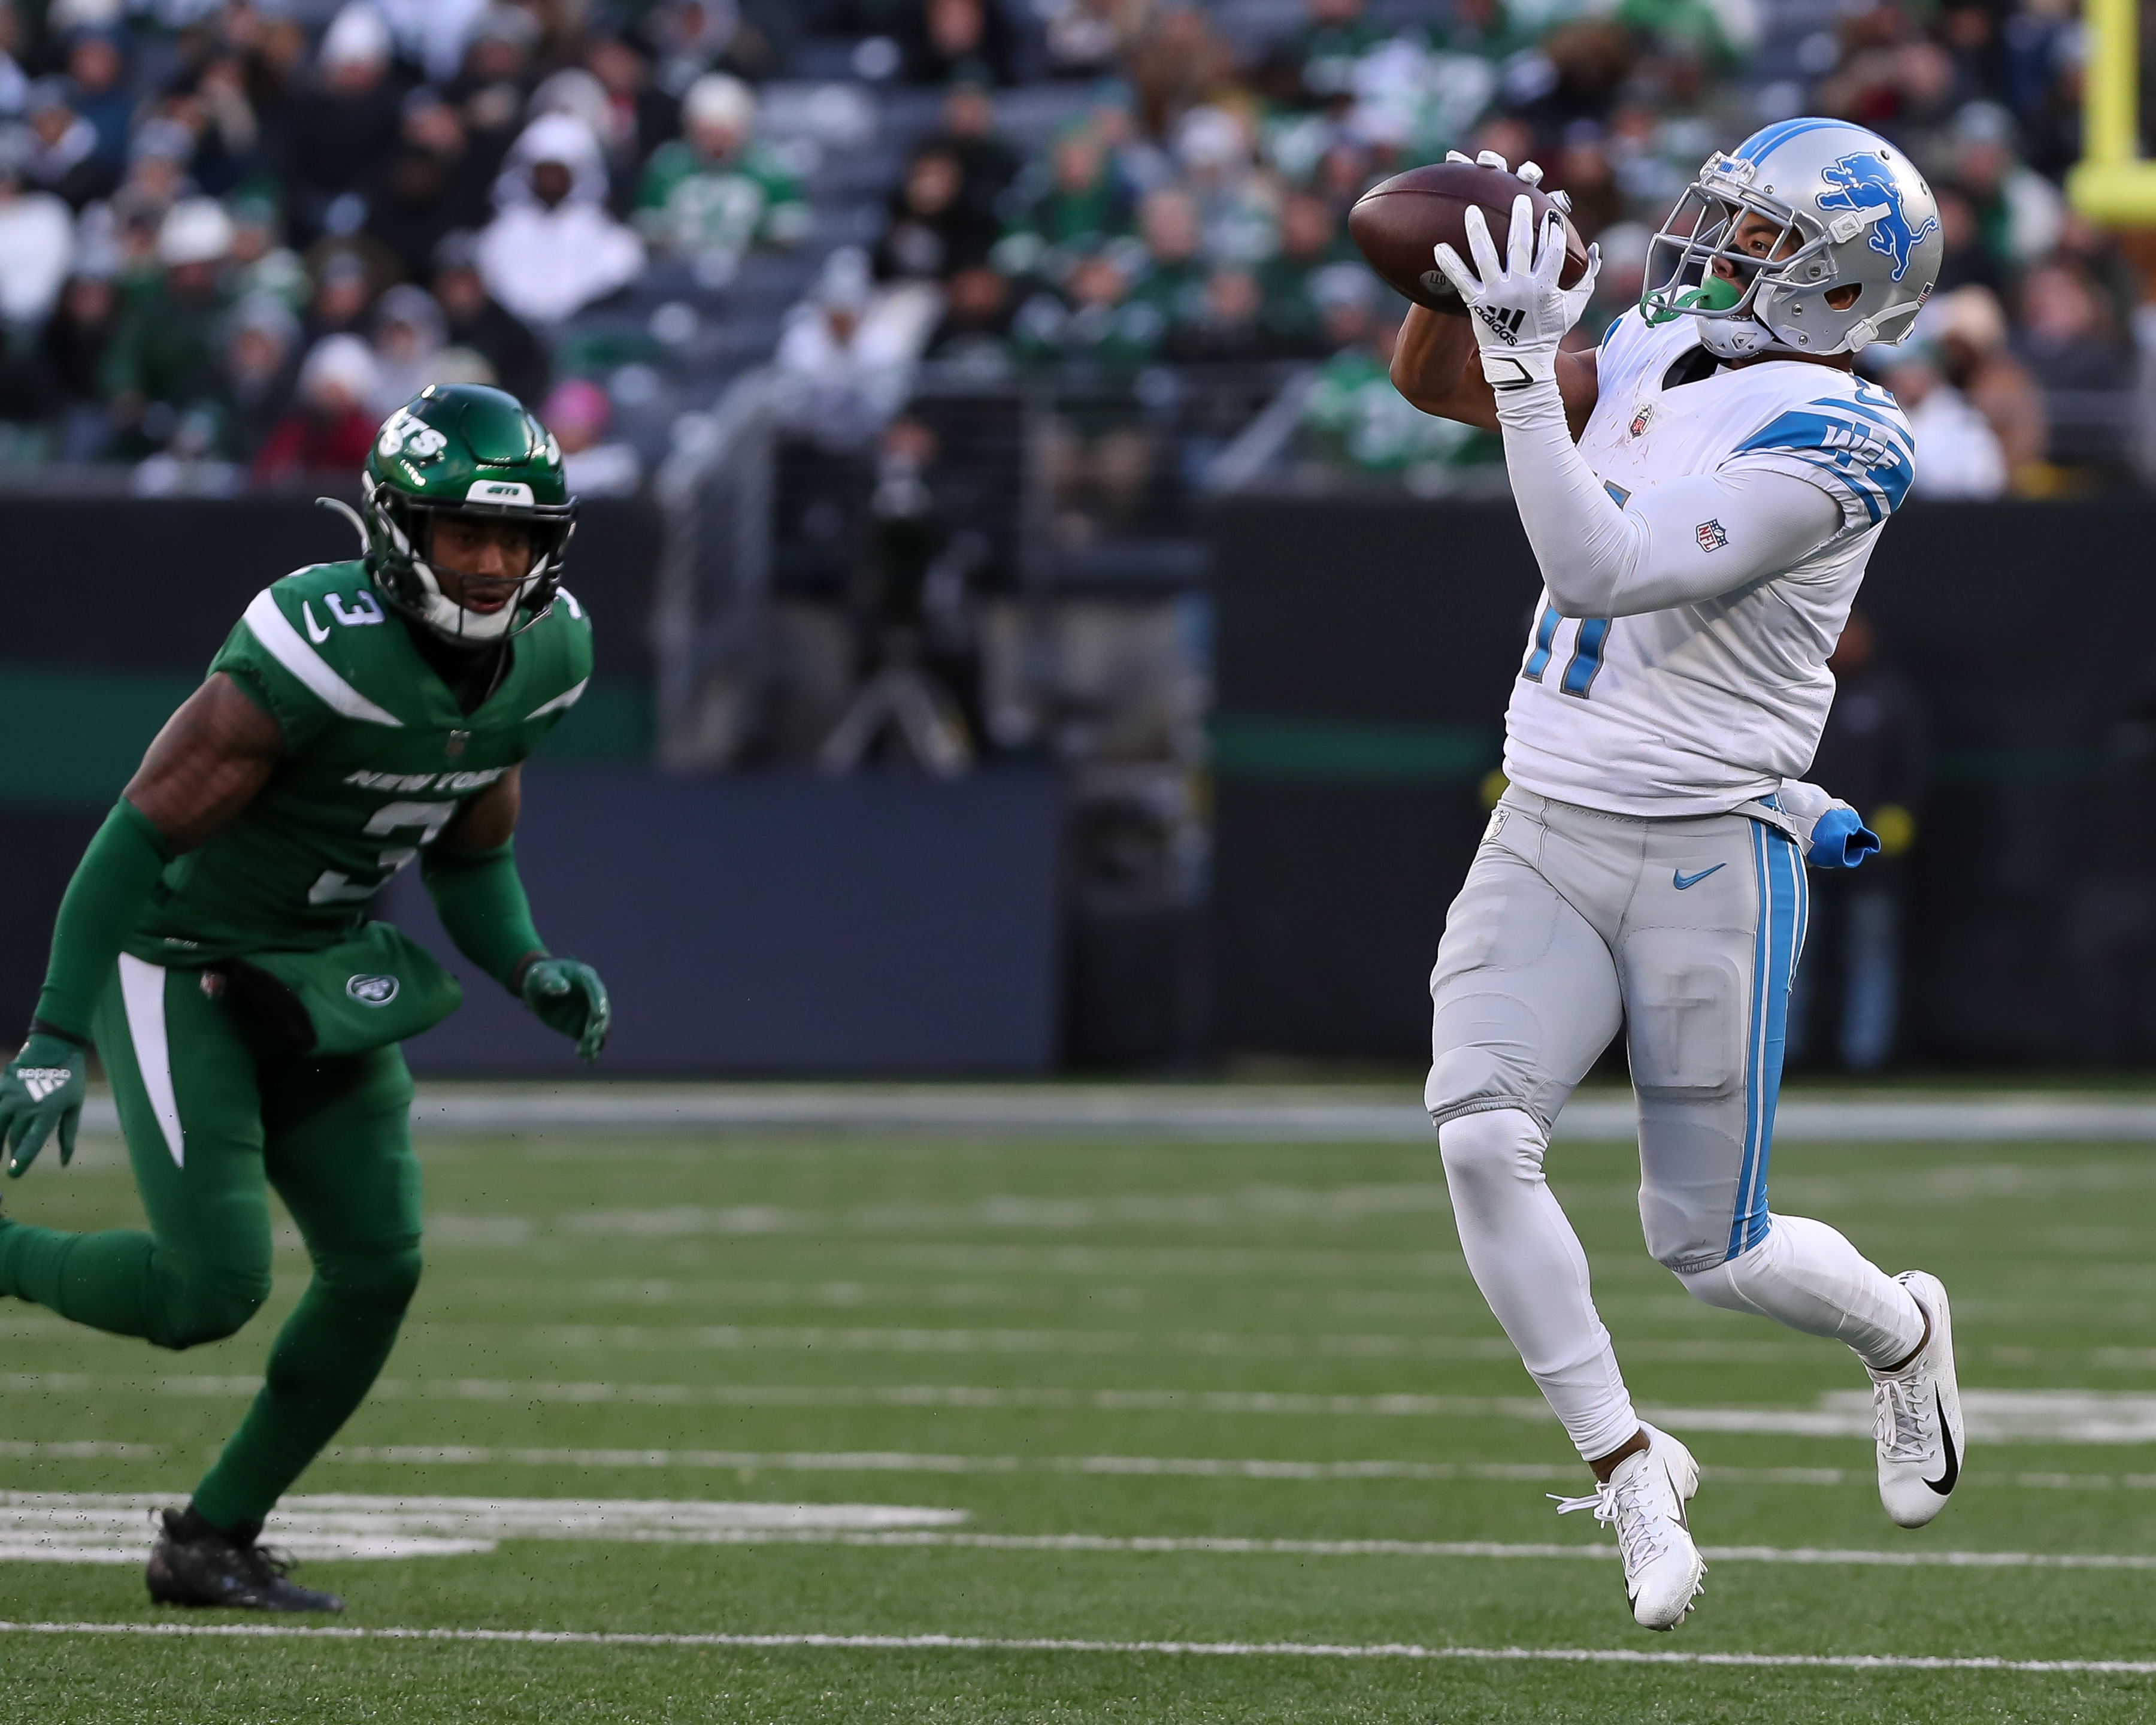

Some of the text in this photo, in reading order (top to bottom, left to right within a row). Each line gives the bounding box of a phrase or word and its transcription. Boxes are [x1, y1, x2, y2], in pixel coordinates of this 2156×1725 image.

[1474, 306, 1518, 346] adidas
[1821, 424, 1901, 473] WCF
[1698, 525, 1716, 550] NFL
[324, 589, 385, 627] 3
[343, 769, 437, 792] NEW
[307, 801, 458, 904] 3
[17, 1068, 71, 1079] adidas
